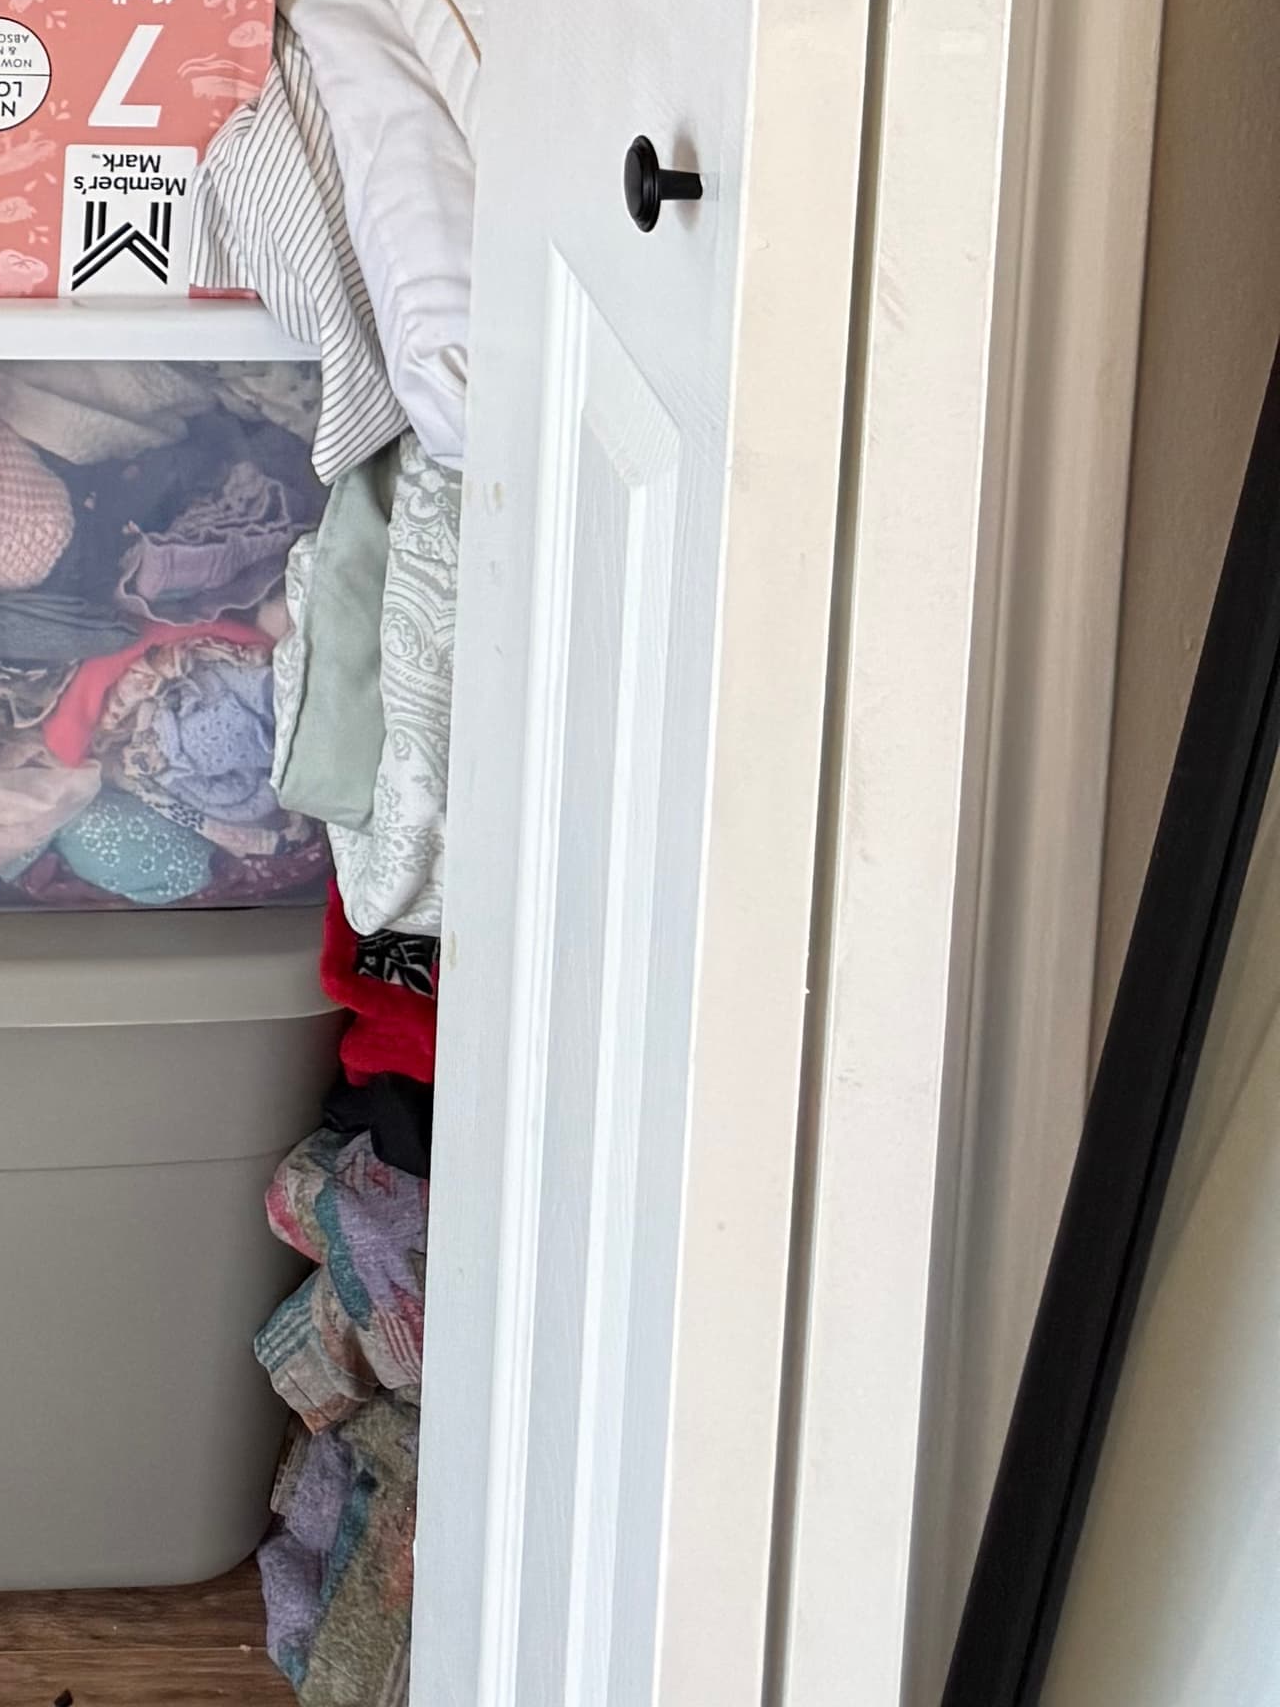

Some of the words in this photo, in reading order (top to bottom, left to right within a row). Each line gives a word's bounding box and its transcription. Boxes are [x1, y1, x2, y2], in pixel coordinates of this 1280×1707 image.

[7, 44, 17, 56] &
[2, 57, 32, 68] NOW
[87, 23, 164, 128] 7
[73, 175, 187, 197] Member's
